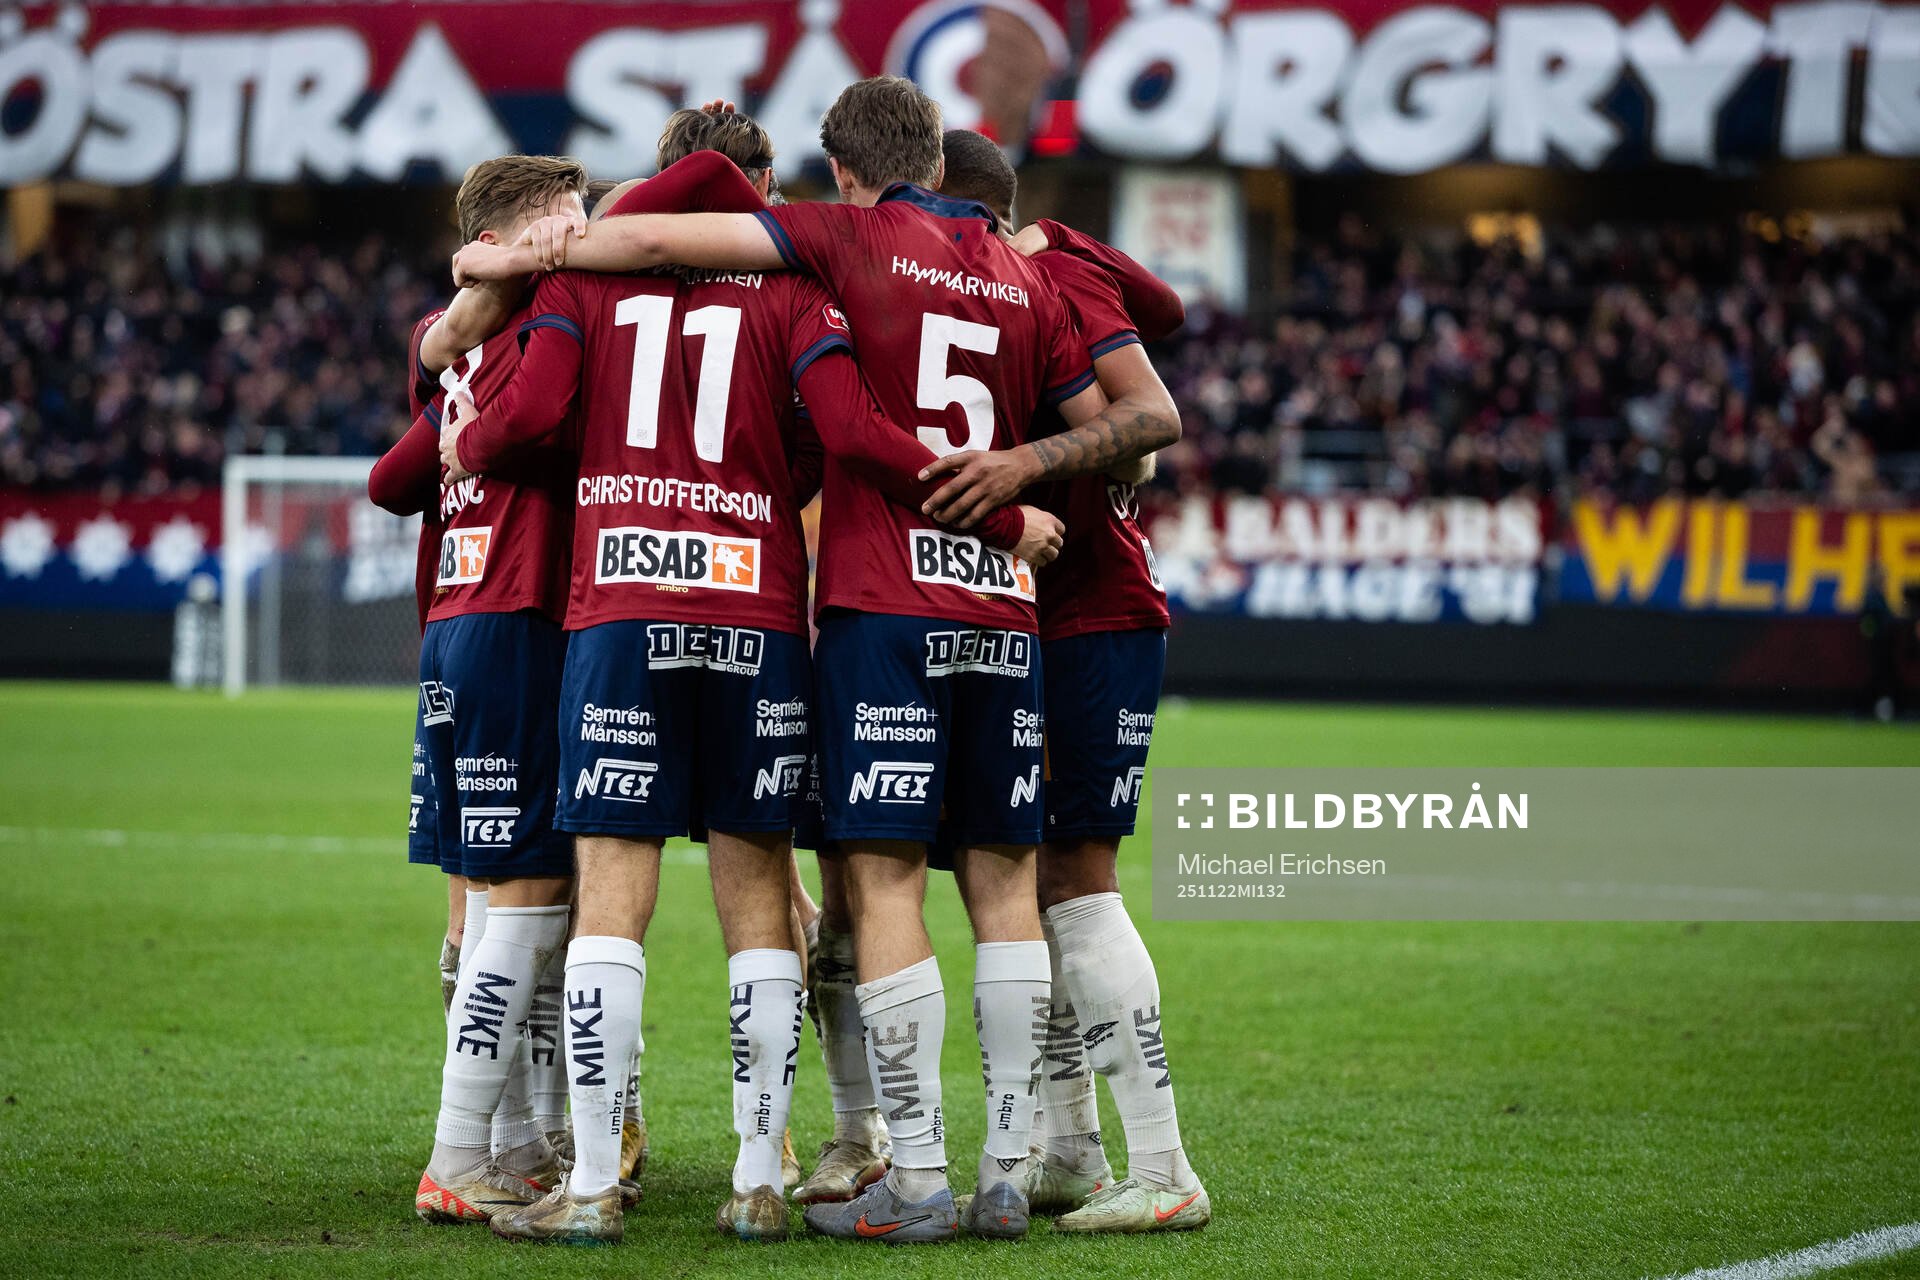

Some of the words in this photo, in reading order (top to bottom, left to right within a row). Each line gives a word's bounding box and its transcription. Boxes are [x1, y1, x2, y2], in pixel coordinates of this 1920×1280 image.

[0, 5, 517, 187] ÖSTRA
[566, 0, 868, 184] STÅ
[614, 294, 742, 463] 11
[916, 312, 1000, 460] 5
[577, 474, 772, 523] CHRISTOFFERSSON
[601, 533, 707, 580] BESAB
[916, 535, 1015, 589] BESAB
[656, 584, 689, 593] umbro
[726, 663, 760, 677] GROUP
[998, 667, 1029, 678] GROUP
[581, 722, 656, 746] Månsson
[854, 721, 936, 742] Månsson
[575, 757, 658, 803] NTEX
[849, 761, 935, 804] NTEX
[456, 971, 517, 1060] MIKE
[568, 987, 606, 1086] MIKE
[1133, 1005, 1171, 1089] MIKE
[871, 1021, 925, 1121] MIKE
[610, 1090, 623, 1135] umbro
[754, 1093, 771, 1135] umbro
[933, 1106, 944, 1142] umbro
[998, 1093, 1015, 1130] umbro
